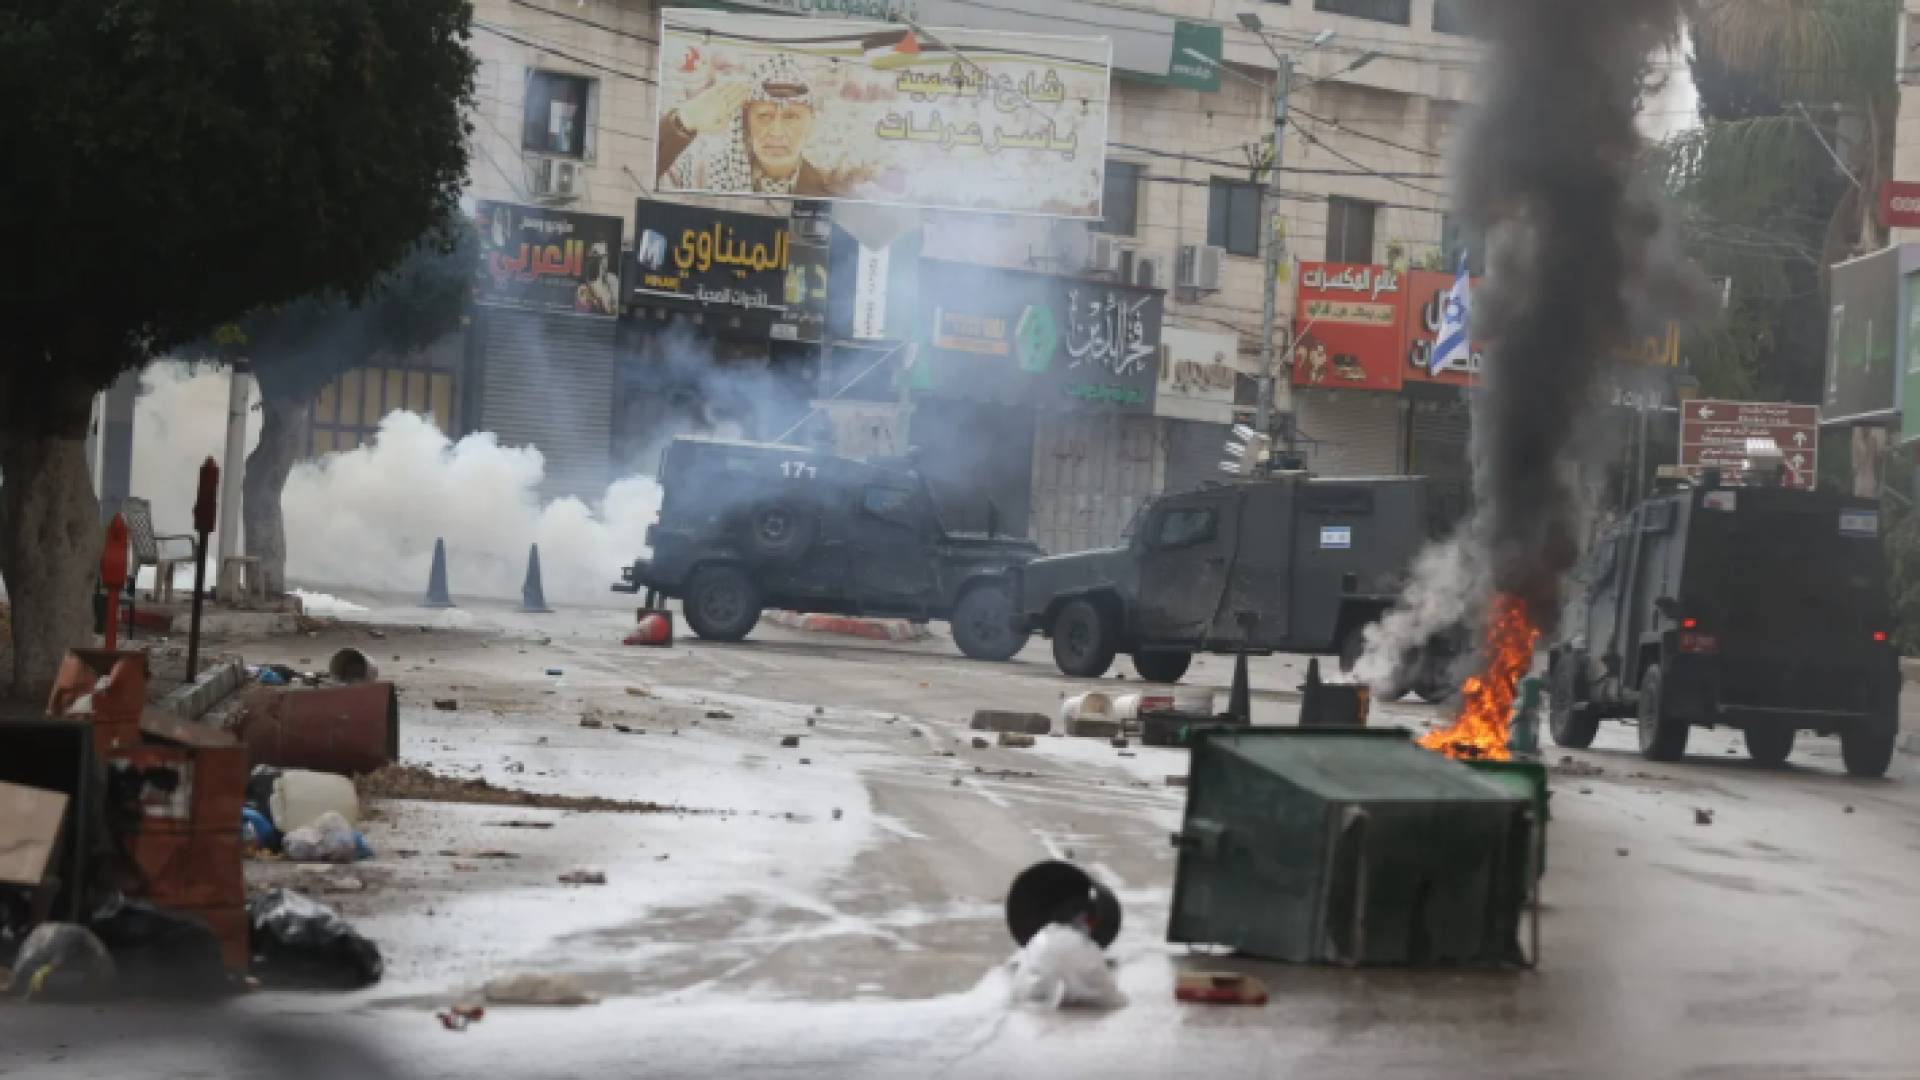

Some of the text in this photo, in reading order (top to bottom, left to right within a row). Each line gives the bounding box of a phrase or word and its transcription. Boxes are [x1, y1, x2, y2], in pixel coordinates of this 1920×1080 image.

[994, 68, 1065, 112] شارع
[876, 109, 1078, 161] ياسر عرفات
[489, 239, 585, 289] العربي
[674, 222, 789, 279] الميناوي
